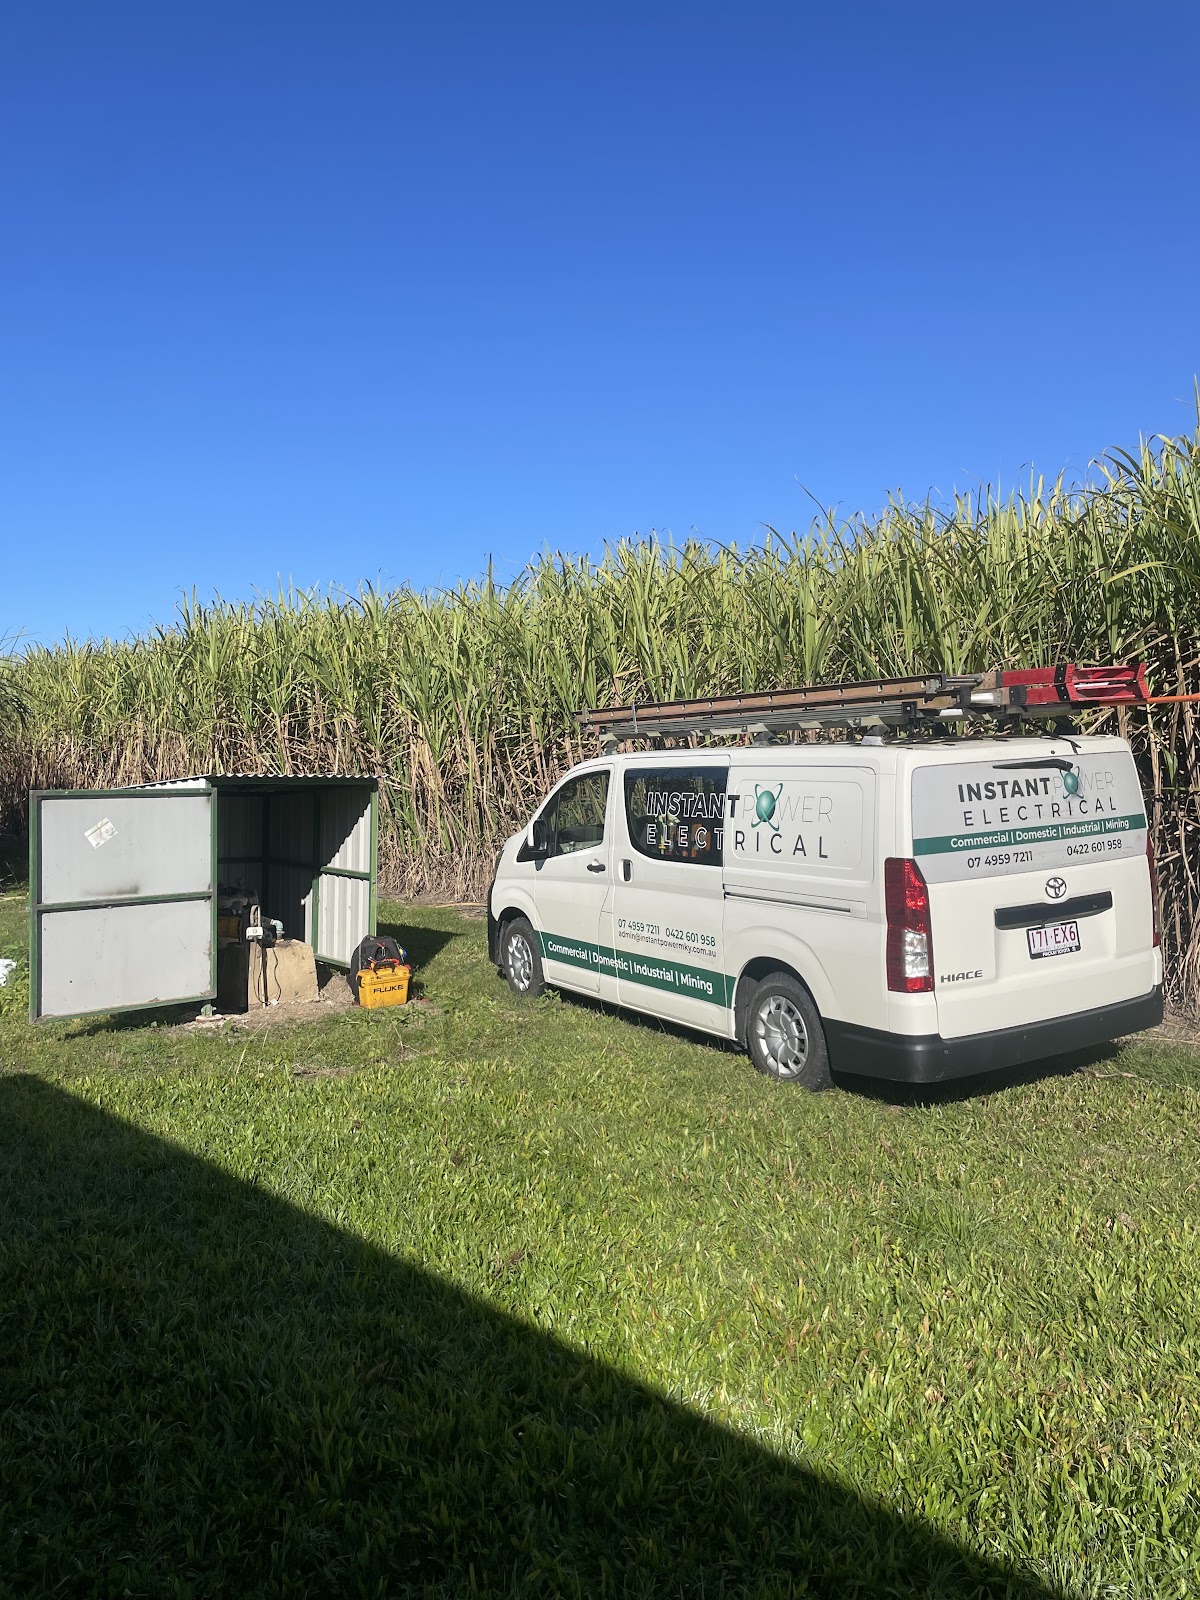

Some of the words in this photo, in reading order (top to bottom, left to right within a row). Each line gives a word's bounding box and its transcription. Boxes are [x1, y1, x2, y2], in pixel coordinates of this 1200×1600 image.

[957, 777, 1050, 803] INSTANT
[646, 792, 741, 819] INSTANT
[963, 797, 1117, 827] ELECTRICAL
[646, 823, 829, 859] ELECTRICAL
[950, 831, 1009, 849] Commercial
[1015, 827, 1057, 841] Domestic
[1063, 822, 1101, 836] Industrial
[1105, 819, 1129, 831] Mining
[967, 857, 981, 869] 07
[984, 853, 1011, 867] 4959
[1013, 850, 1033, 864] 7211
[1066, 844, 1090, 856] 0422
[1091, 841, 1106, 853] 601
[1107, 838, 1122, 850] 958
[617, 918, 627, 929] 07
[627, 920, 645, 932] 4959
[646, 923, 660, 936] 7211
[665, 927, 684, 941] 0422
[685, 931, 699, 943] 601
[700, 934, 716, 947] 958
[547, 940, 588, 961] Commercial
[592, 953, 629, 971] Domestic
[633, 961, 674, 983] Industrial
[680, 972, 713, 995] Mining
[940, 969, 983, 983] HIACE
[373, 984, 404, 994] FLUKE
